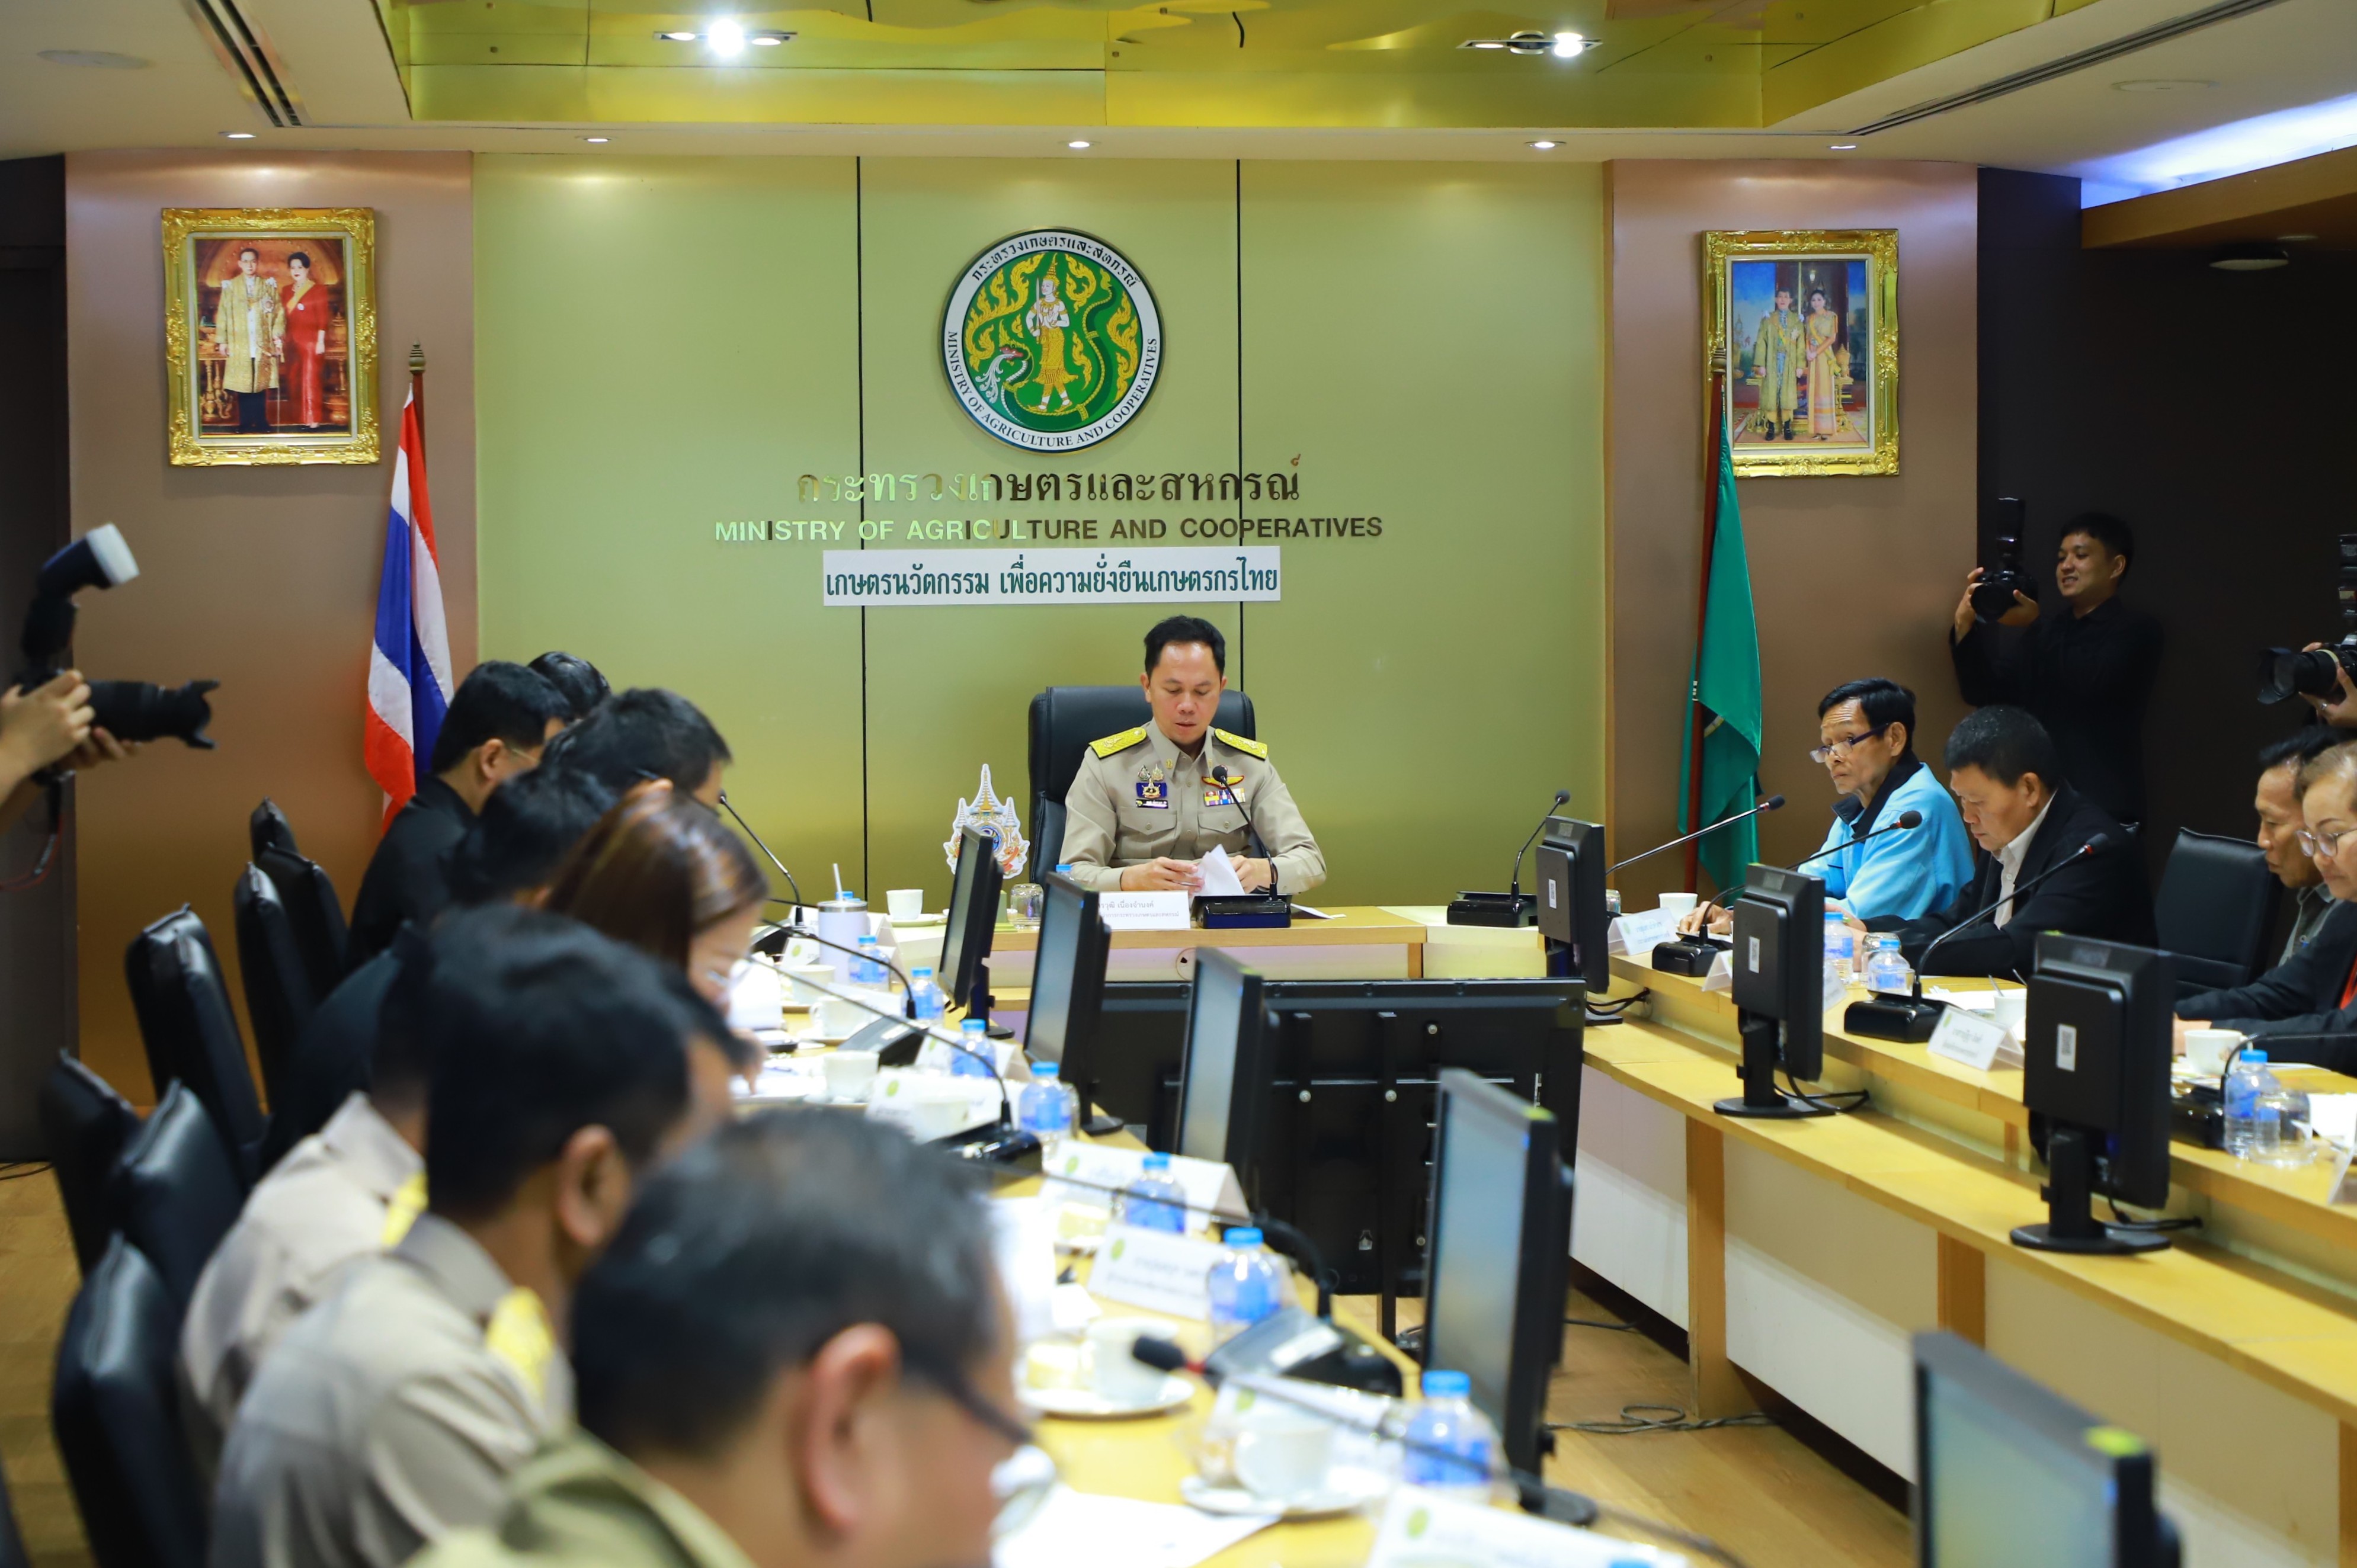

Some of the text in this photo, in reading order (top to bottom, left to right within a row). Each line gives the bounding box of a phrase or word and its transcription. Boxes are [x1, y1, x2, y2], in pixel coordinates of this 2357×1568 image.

[972, 236, 1141, 288] กระทรวงเกษตรและสหกรณ์
[948, 331, 1157, 447] MINISTRY OF AGRICULTURE AND COOPERATIVES
[797, 454, 1301, 501] กระทรวงเกษตรและสหกรณ์
[715, 517, 1383, 541] MINISTRY OF AGRICULTURE AND COOPERATIVES
[827, 553, 1278, 595] เกษตรนวัตกรรม เพื่อความยั่งยืนเกษตรกรไทย
